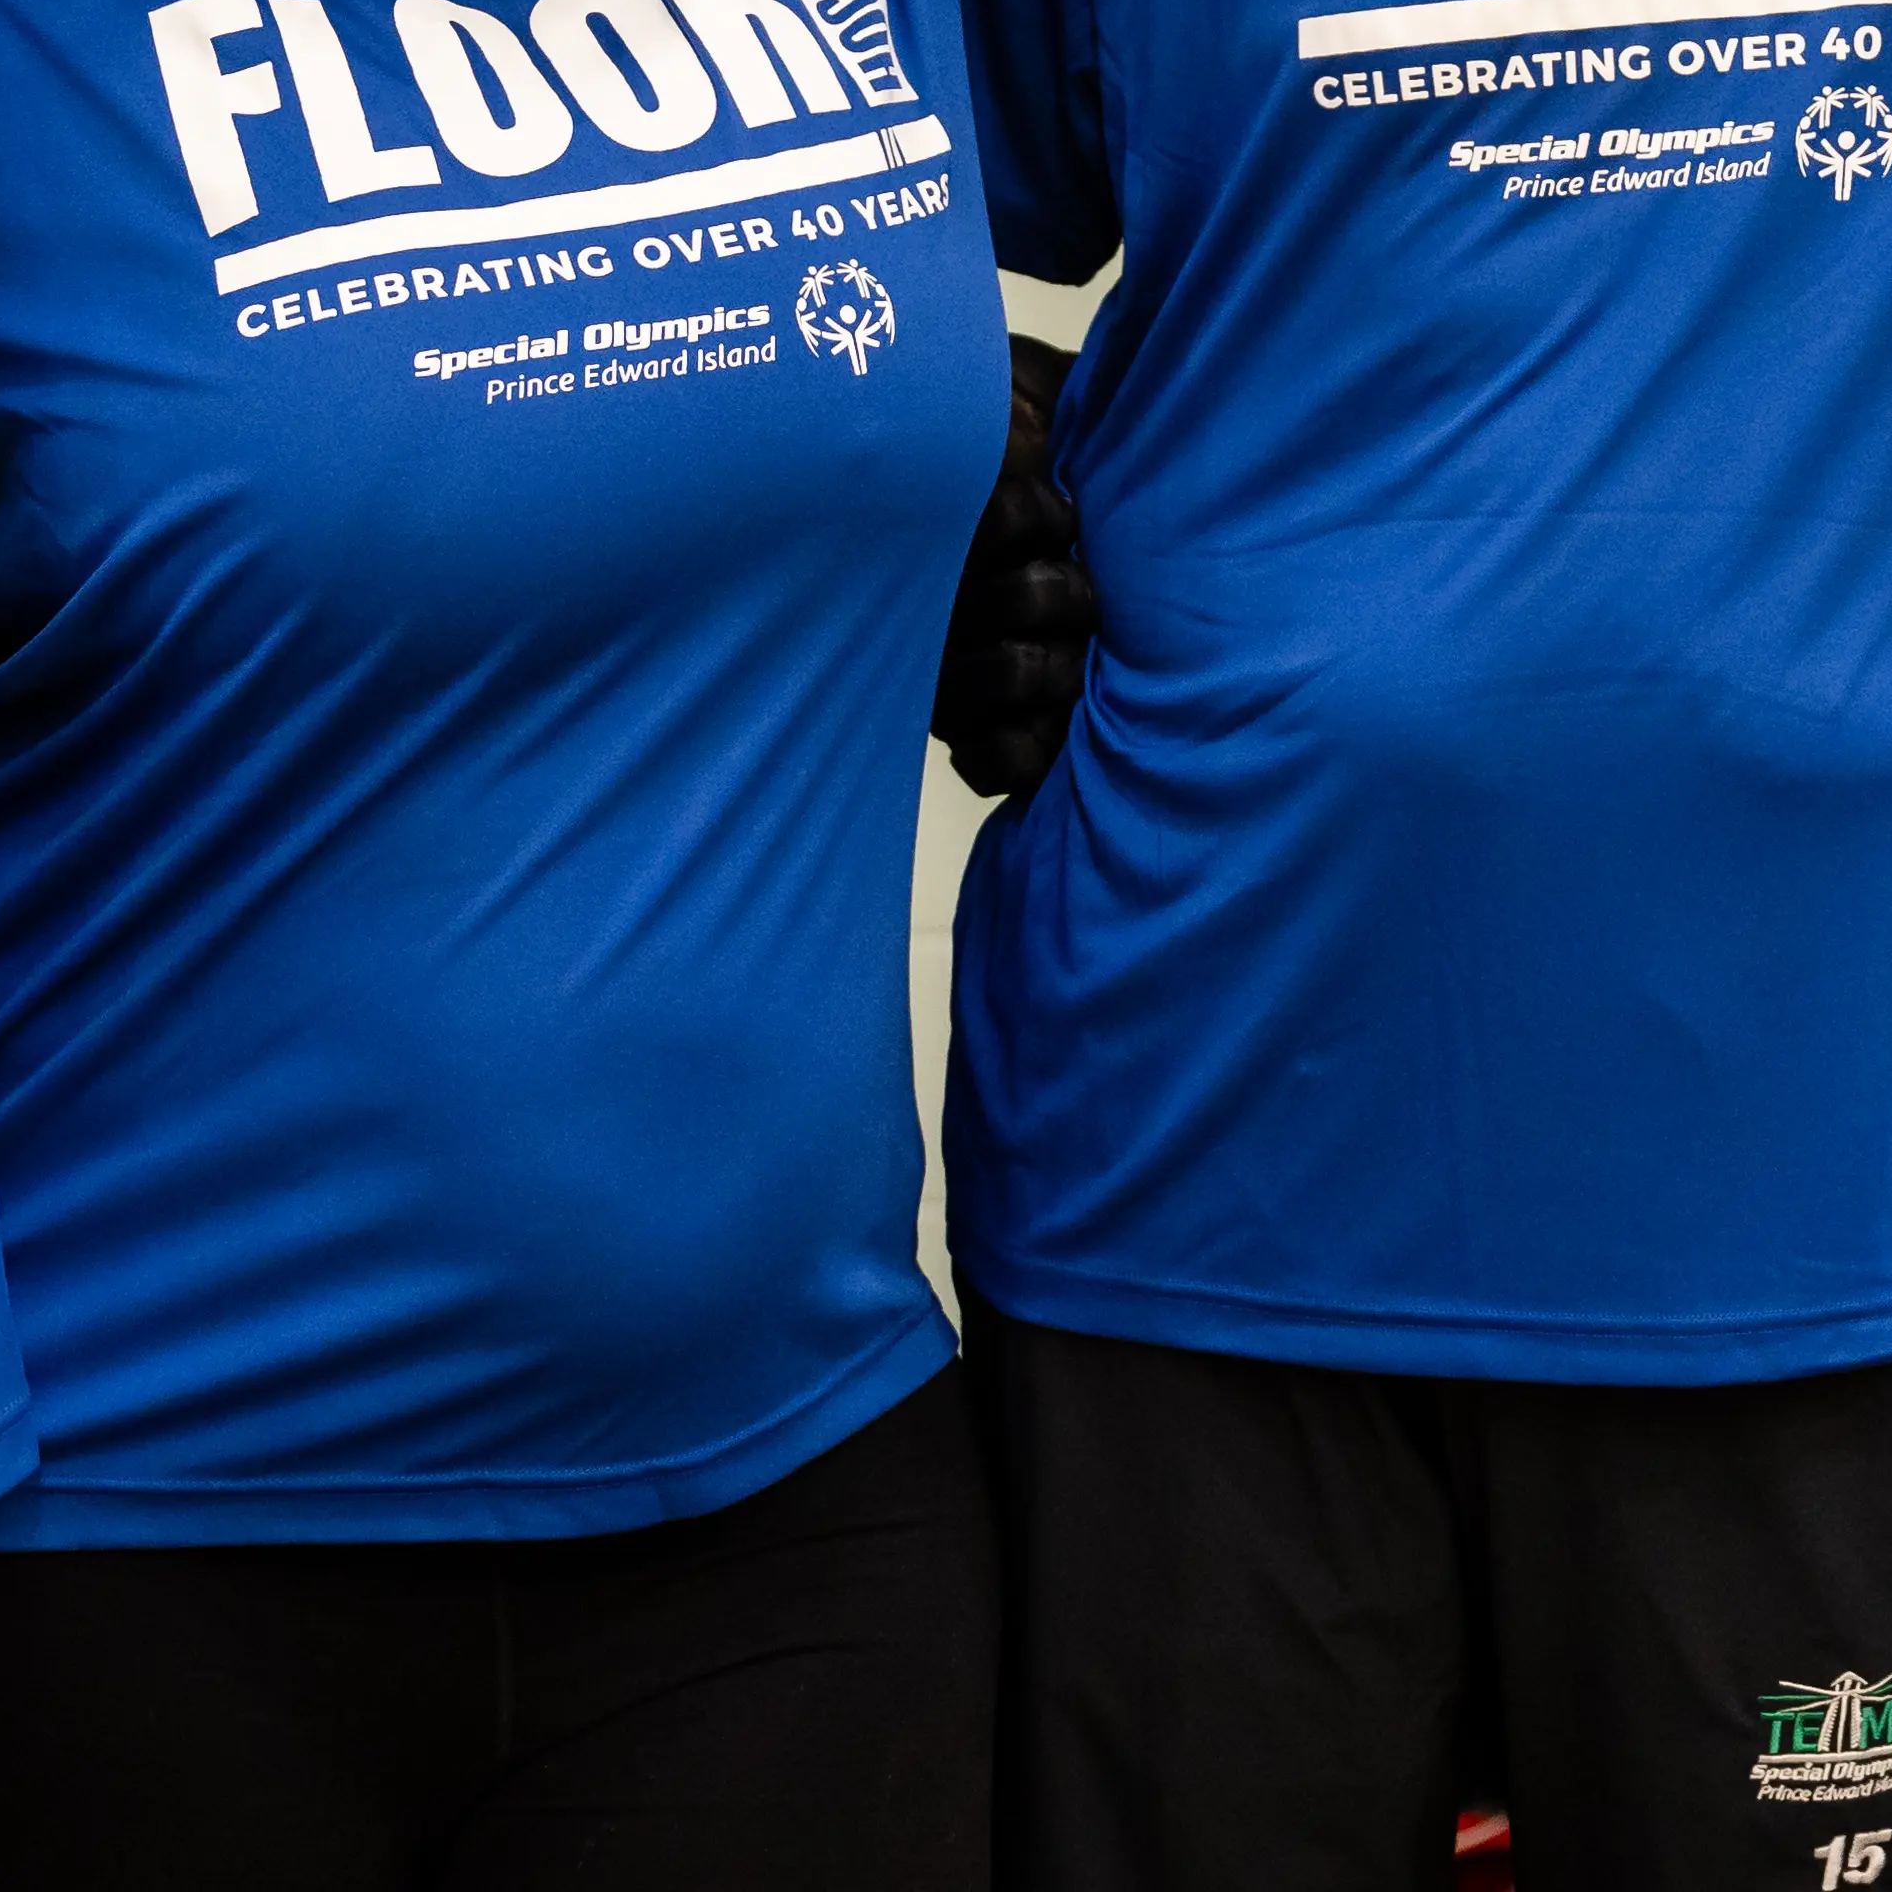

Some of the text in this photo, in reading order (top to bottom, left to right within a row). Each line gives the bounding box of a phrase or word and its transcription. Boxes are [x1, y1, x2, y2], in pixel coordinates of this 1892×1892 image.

[1313, 46, 1653, 110] CELEBRATING
[1668, 31, 1806, 76] OVER
[1819, 24, 1882, 61] 40
[1449, 119, 1775, 173] Special Olympics
[1503, 153, 1771, 199] Prince Edward Island
[236, 173, 950, 340] CELEBRATING OVER 40 YEARS
[413, 303, 772, 381] Special Olympics
[486, 336, 777, 405] Prince Edward Island
[1749, 1762, 1830, 1785] Special
[1757, 1784, 1812, 1802] Prince
[1813, 1779, 1874, 1802] Edward
